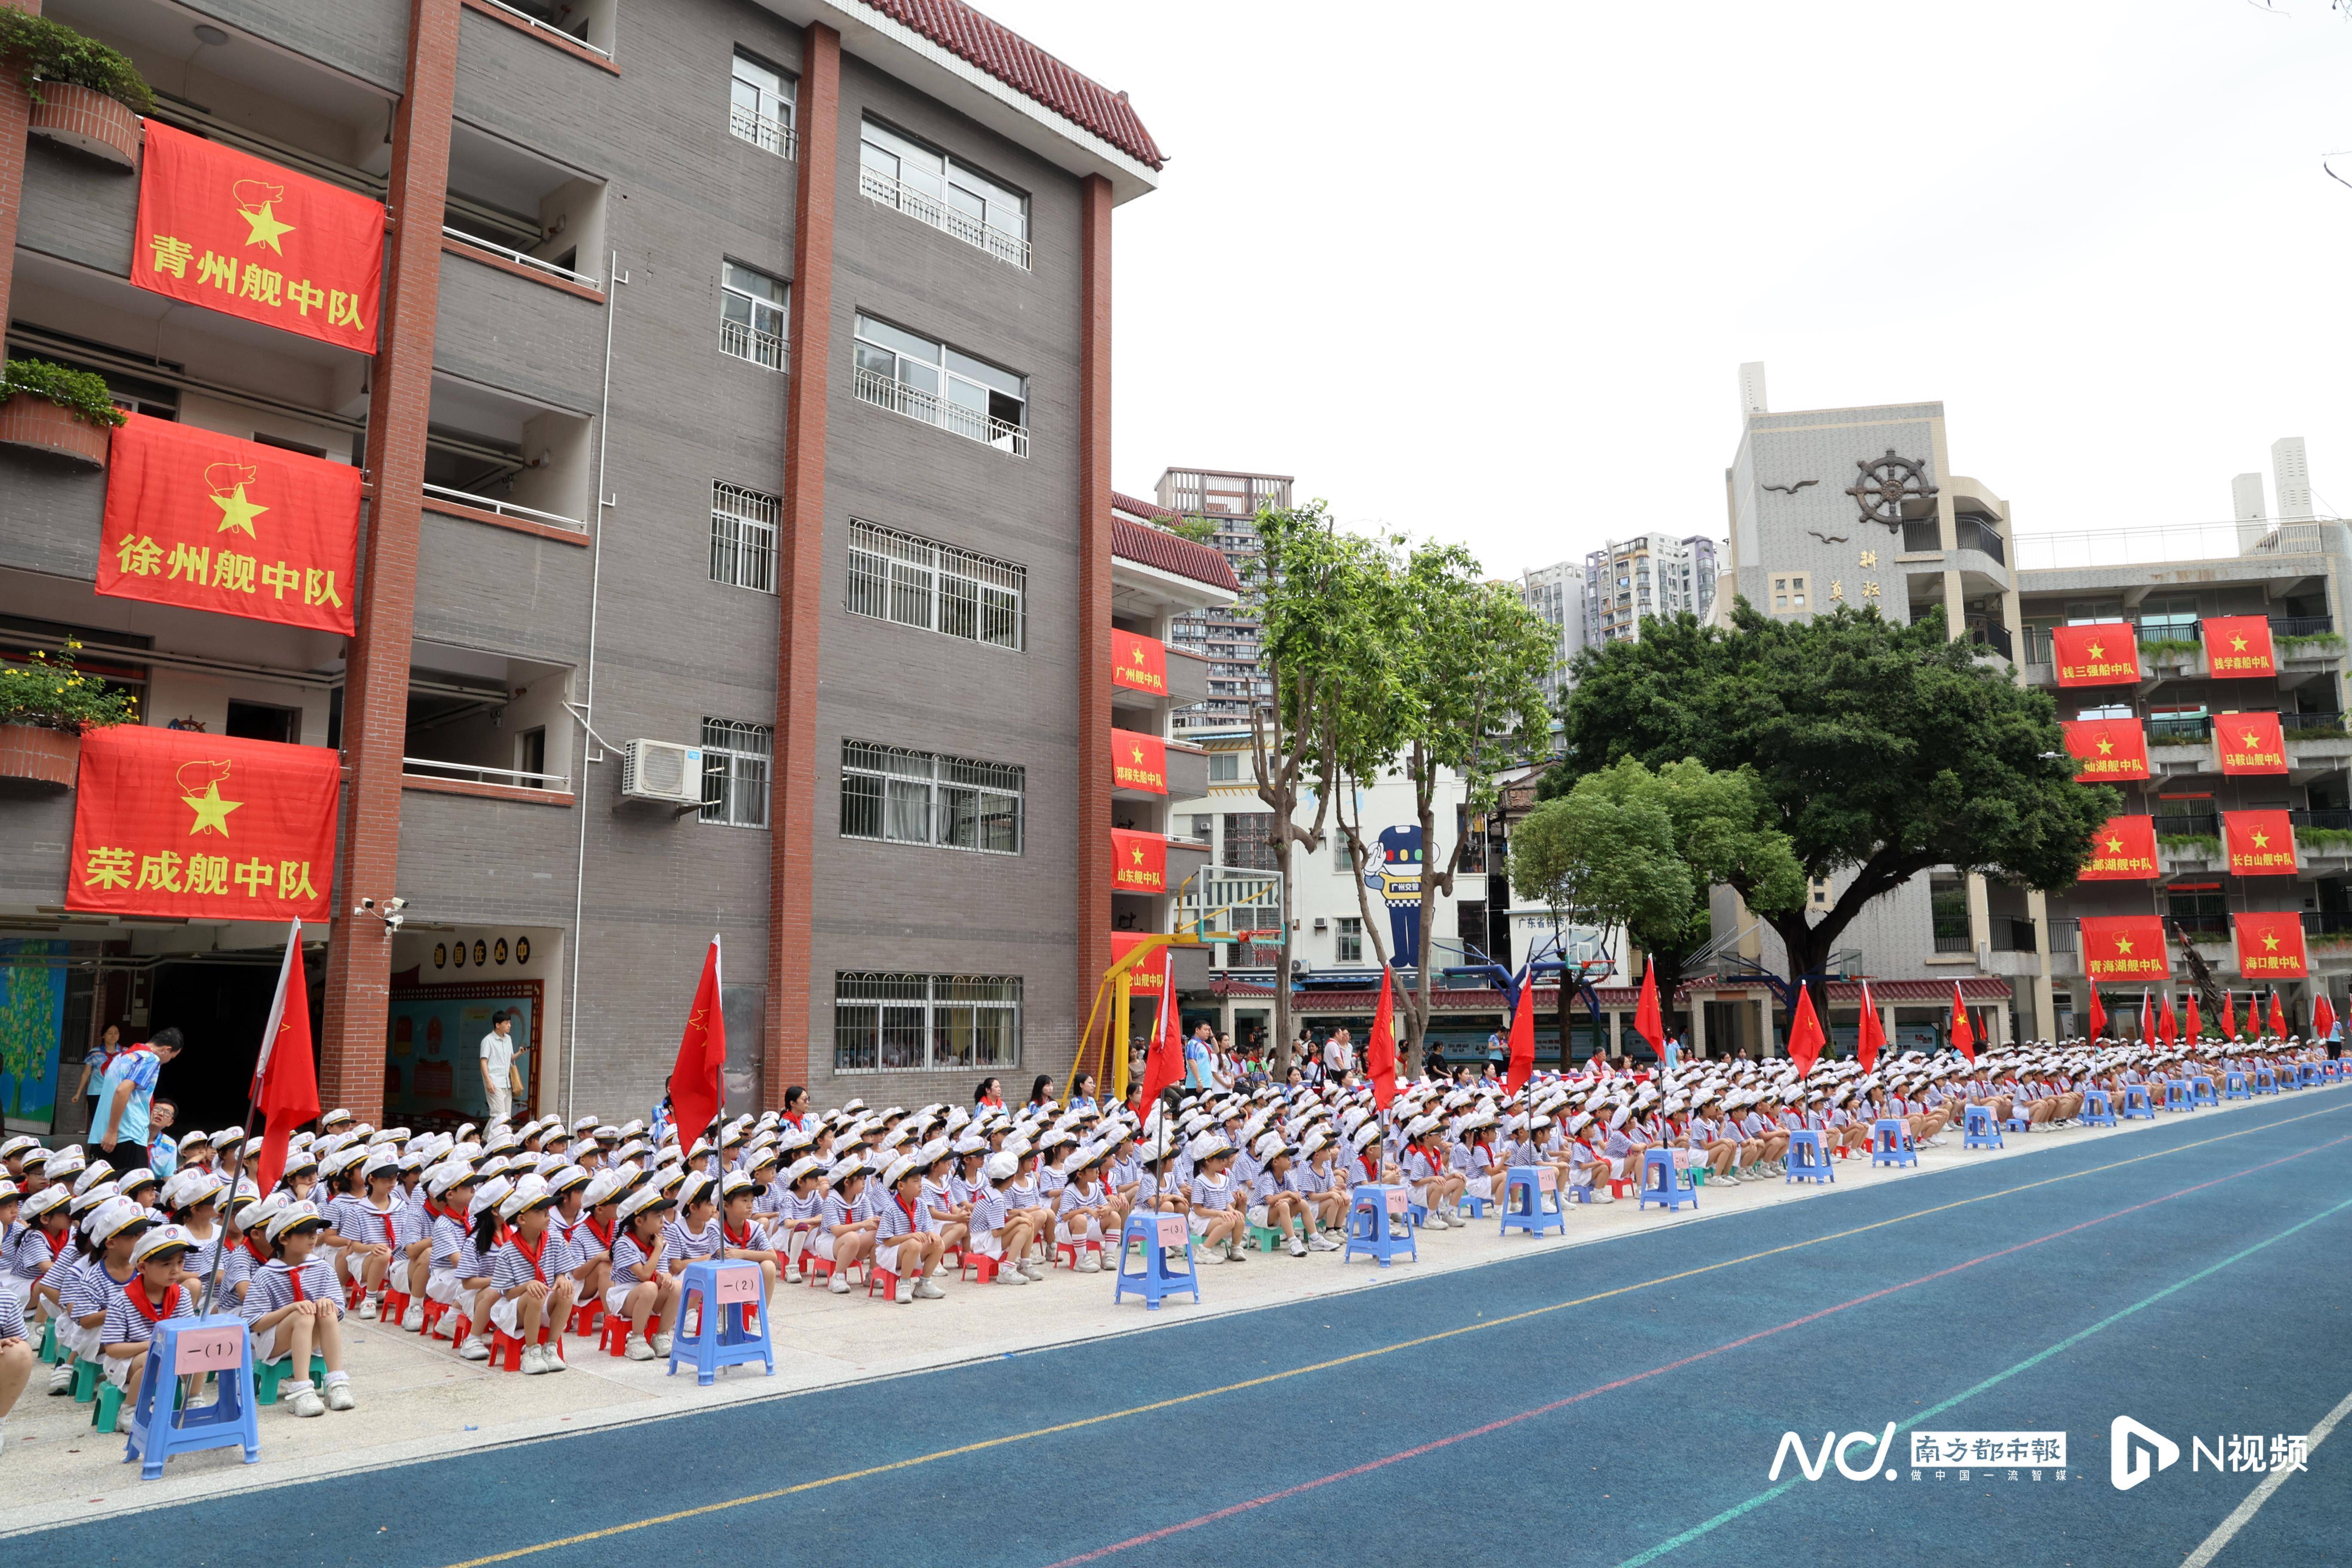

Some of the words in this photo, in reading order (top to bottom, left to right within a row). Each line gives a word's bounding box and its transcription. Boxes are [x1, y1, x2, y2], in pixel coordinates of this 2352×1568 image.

[149, 234, 365, 331] 青州舰中队
[116, 533, 343, 609] 徐州舰中队
[2214, 655, 2270, 670] 钱学森船中队
[1116, 665, 1163, 688] 广州舰中队
[2062, 662, 2135, 679] 钱三强船中队
[2085, 759, 2144, 773] 仙湖舰中队
[2226, 753, 2283, 766] 马鞍山舰中队
[1116, 766, 1163, 787] 邓稼先船中队
[2233, 852, 2294, 867] 长白山舰中队
[84, 846, 318, 901] 荣成舰中队
[1118, 867, 1161, 886] 山东舰中队
[1391, 883, 1419, 891] 广州交警
[1519, 915, 1569, 929] 广东省优秀
[434, 941, 528, 965] 祖国在心中
[2090, 959, 2163, 973] 青海湖舰中队
[2245, 956, 2300, 969] 海口舰中队
[1129, 973, 1164, 988] 仑山舰中队
